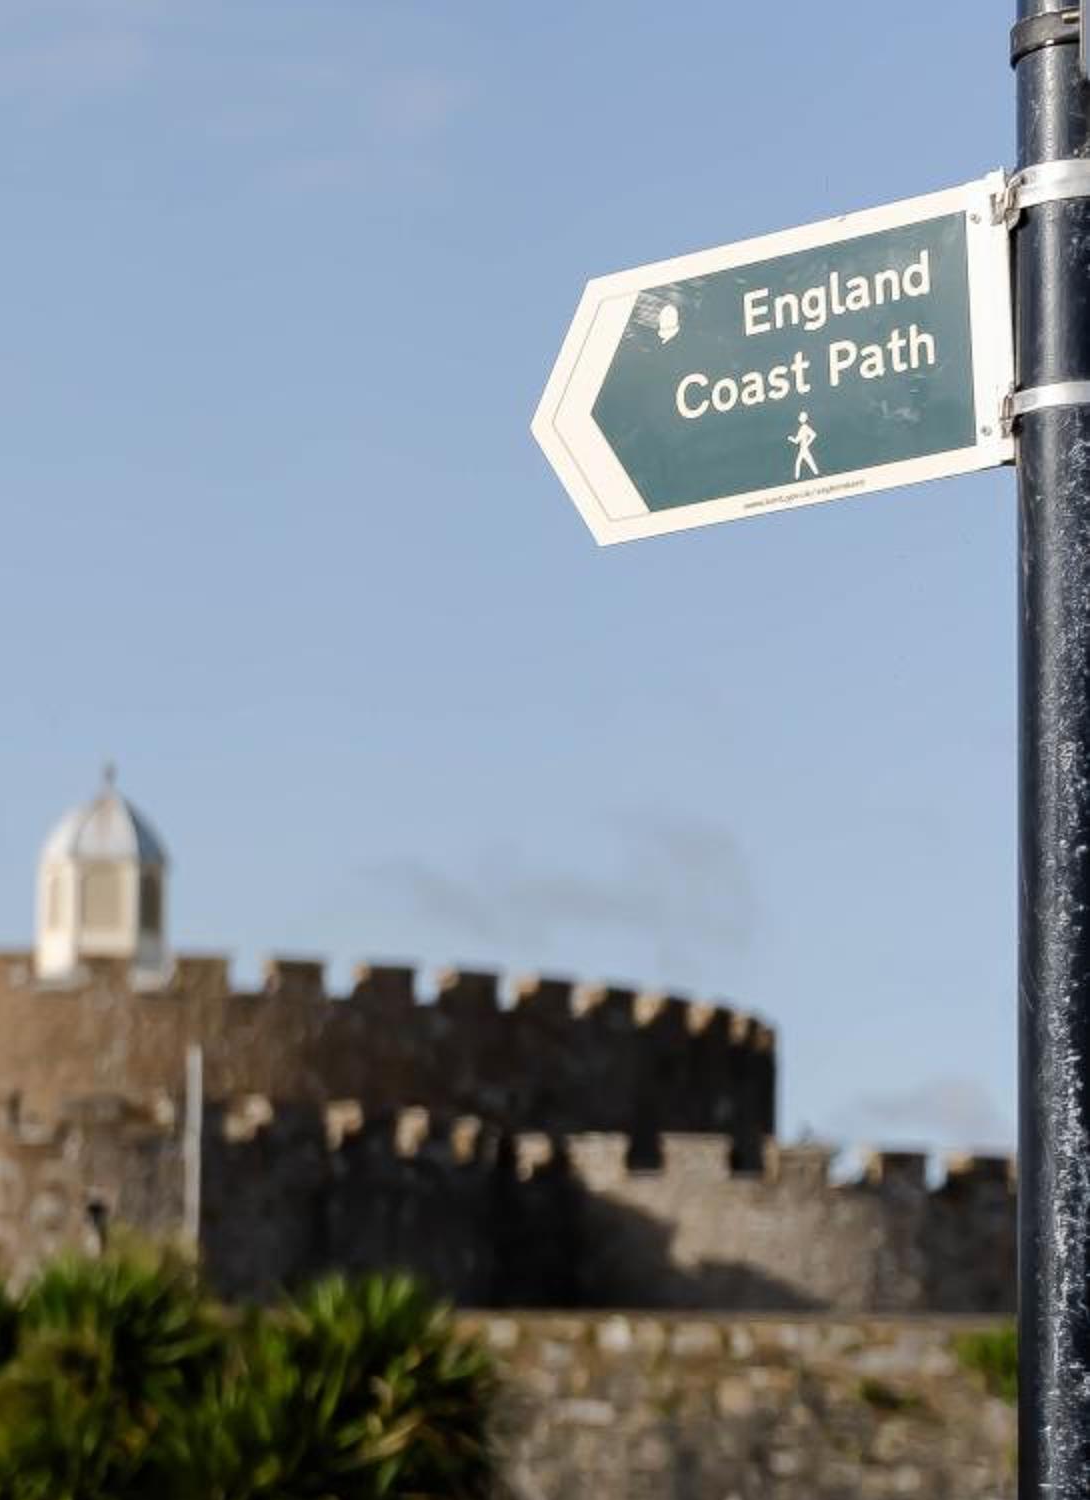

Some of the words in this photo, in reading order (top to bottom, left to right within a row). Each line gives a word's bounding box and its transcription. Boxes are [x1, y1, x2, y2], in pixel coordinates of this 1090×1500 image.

[743, 249, 931, 337] England
[675, 352, 811, 419] Coast
[828, 324, 937, 387] Path
